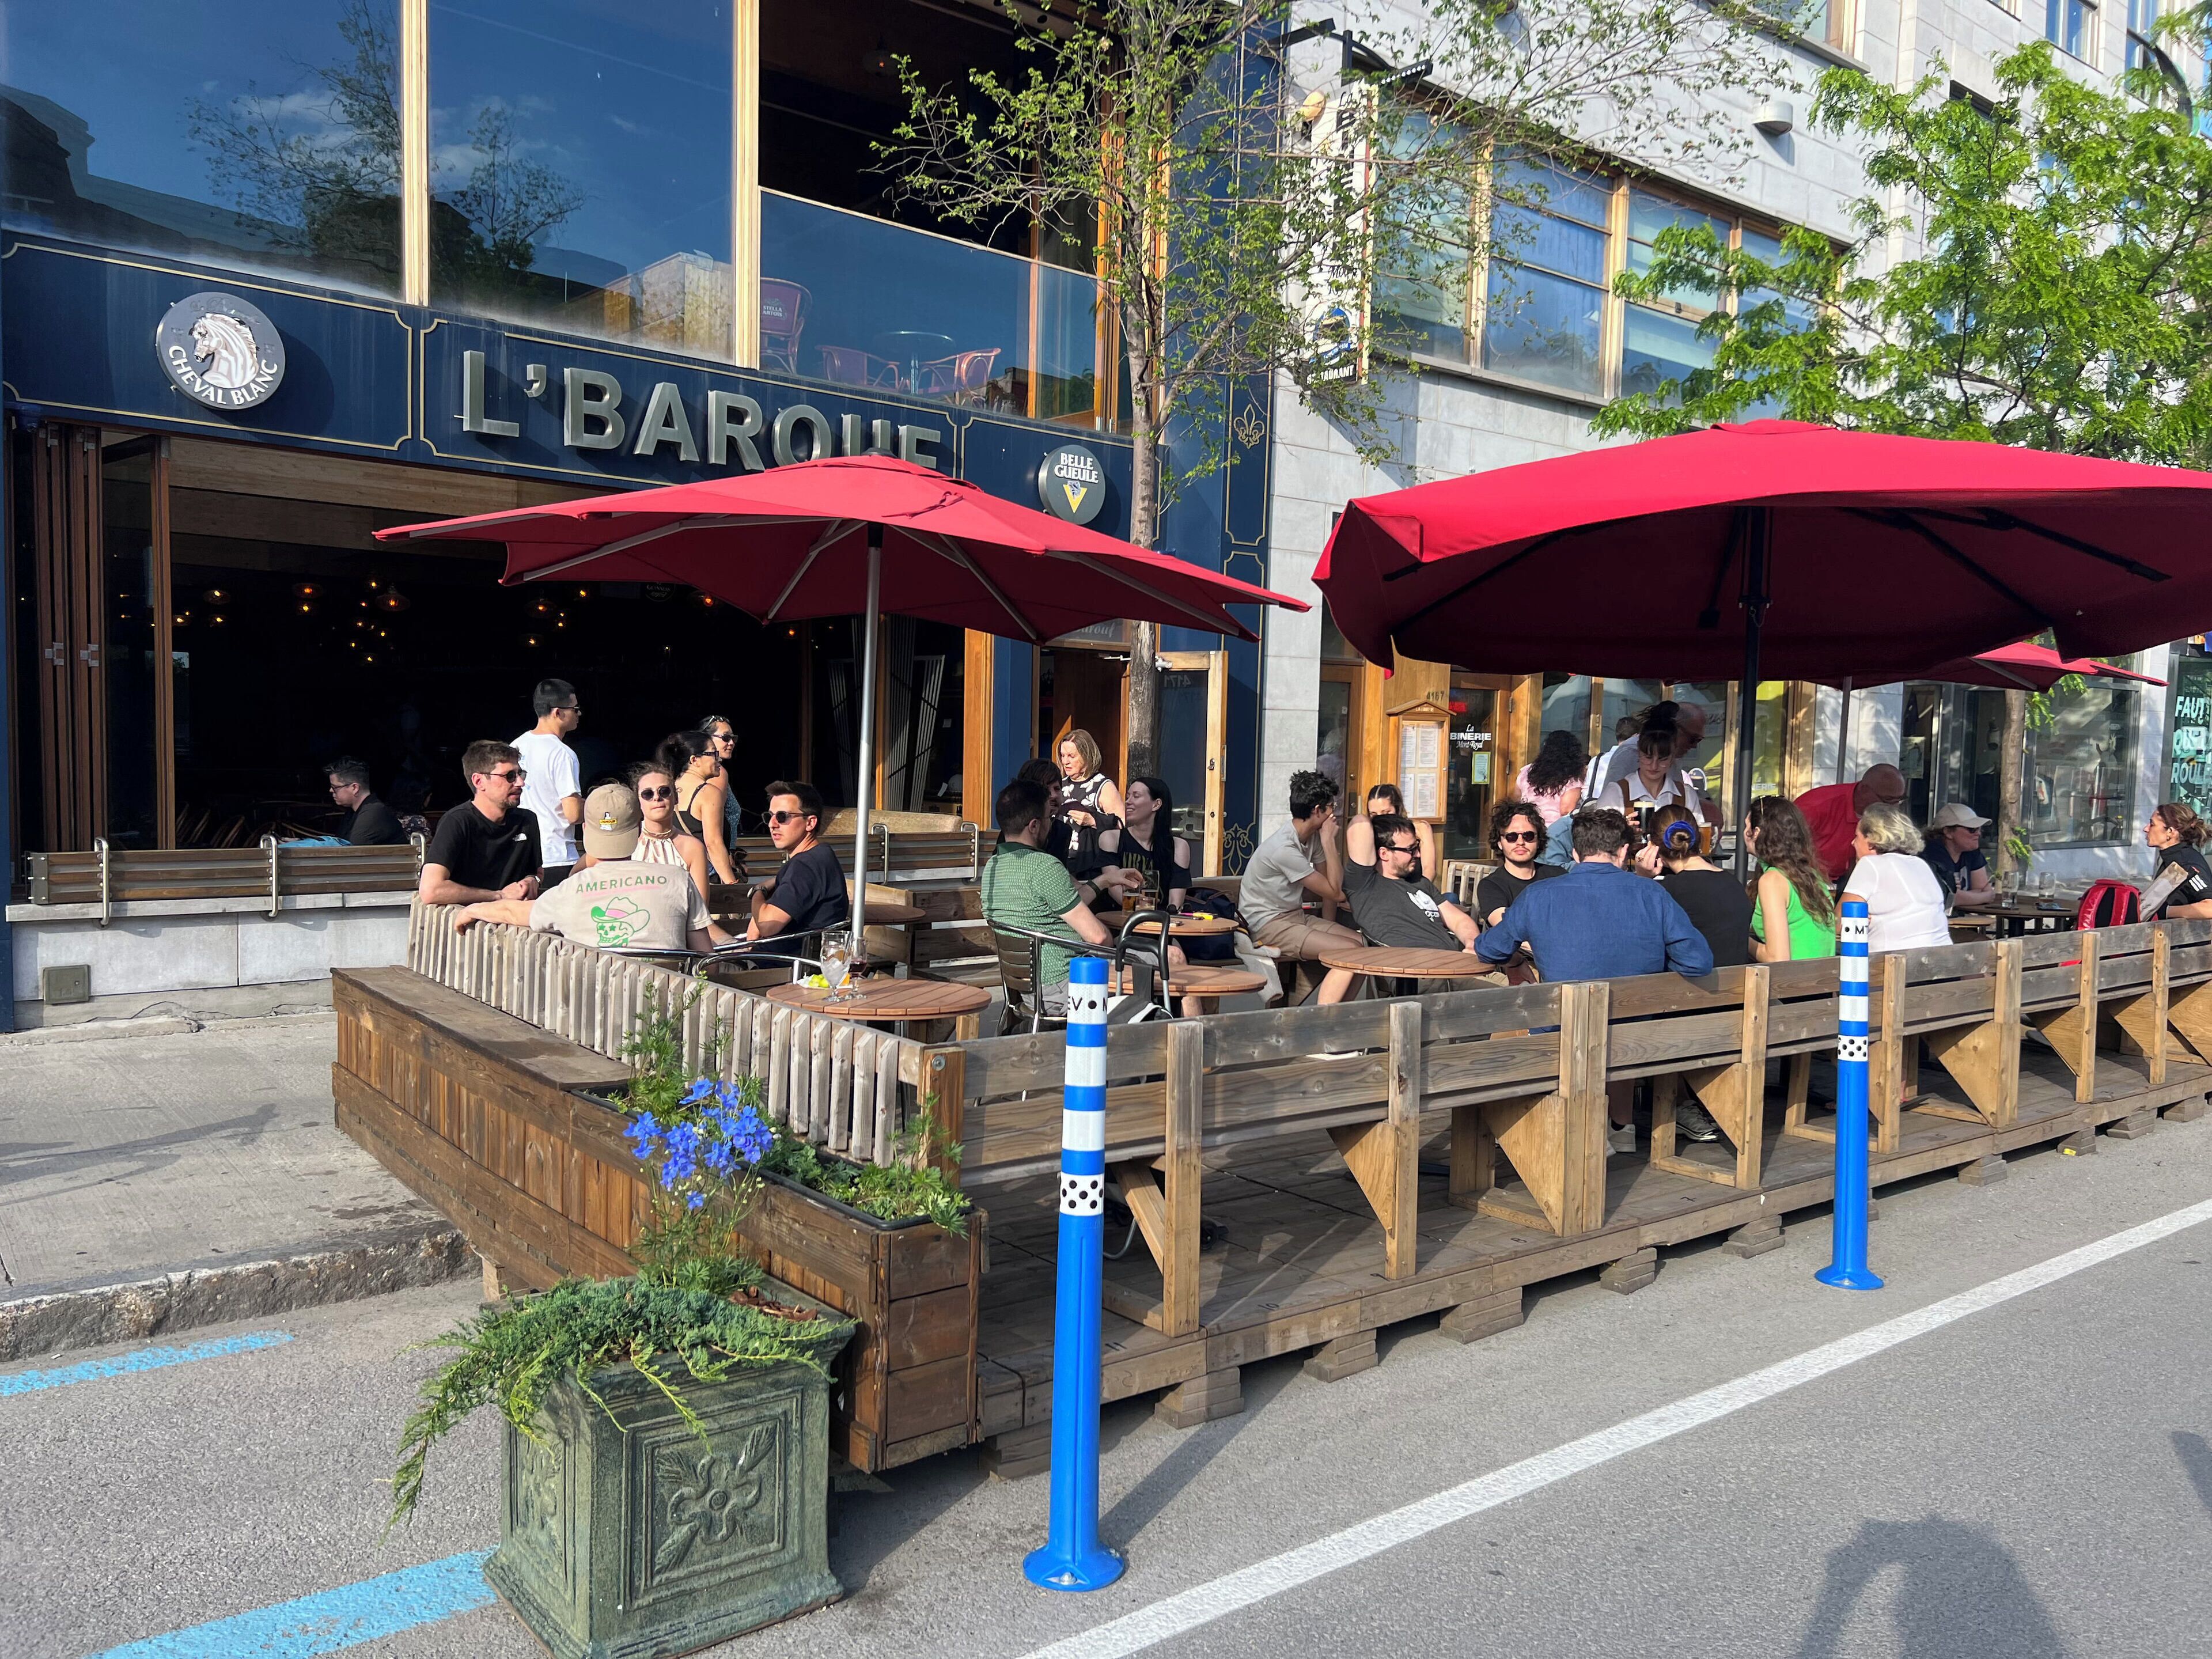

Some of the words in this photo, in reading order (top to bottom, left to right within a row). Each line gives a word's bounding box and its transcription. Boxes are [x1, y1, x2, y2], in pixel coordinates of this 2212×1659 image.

[169, 346, 226, 405] CHEVAL
[230, 359, 278, 406] BLANC
[1060, 452, 1094, 470] BELLE
[1054, 464, 1099, 483] GUEULE
[1426, 691, 1445, 702] 4167
[2175, 695, 2206, 719] FAUT
[1450, 732, 1492, 741] BINERIE
[1465, 724, 1475, 732] La
[576, 875, 667, 893] AMERICANO
